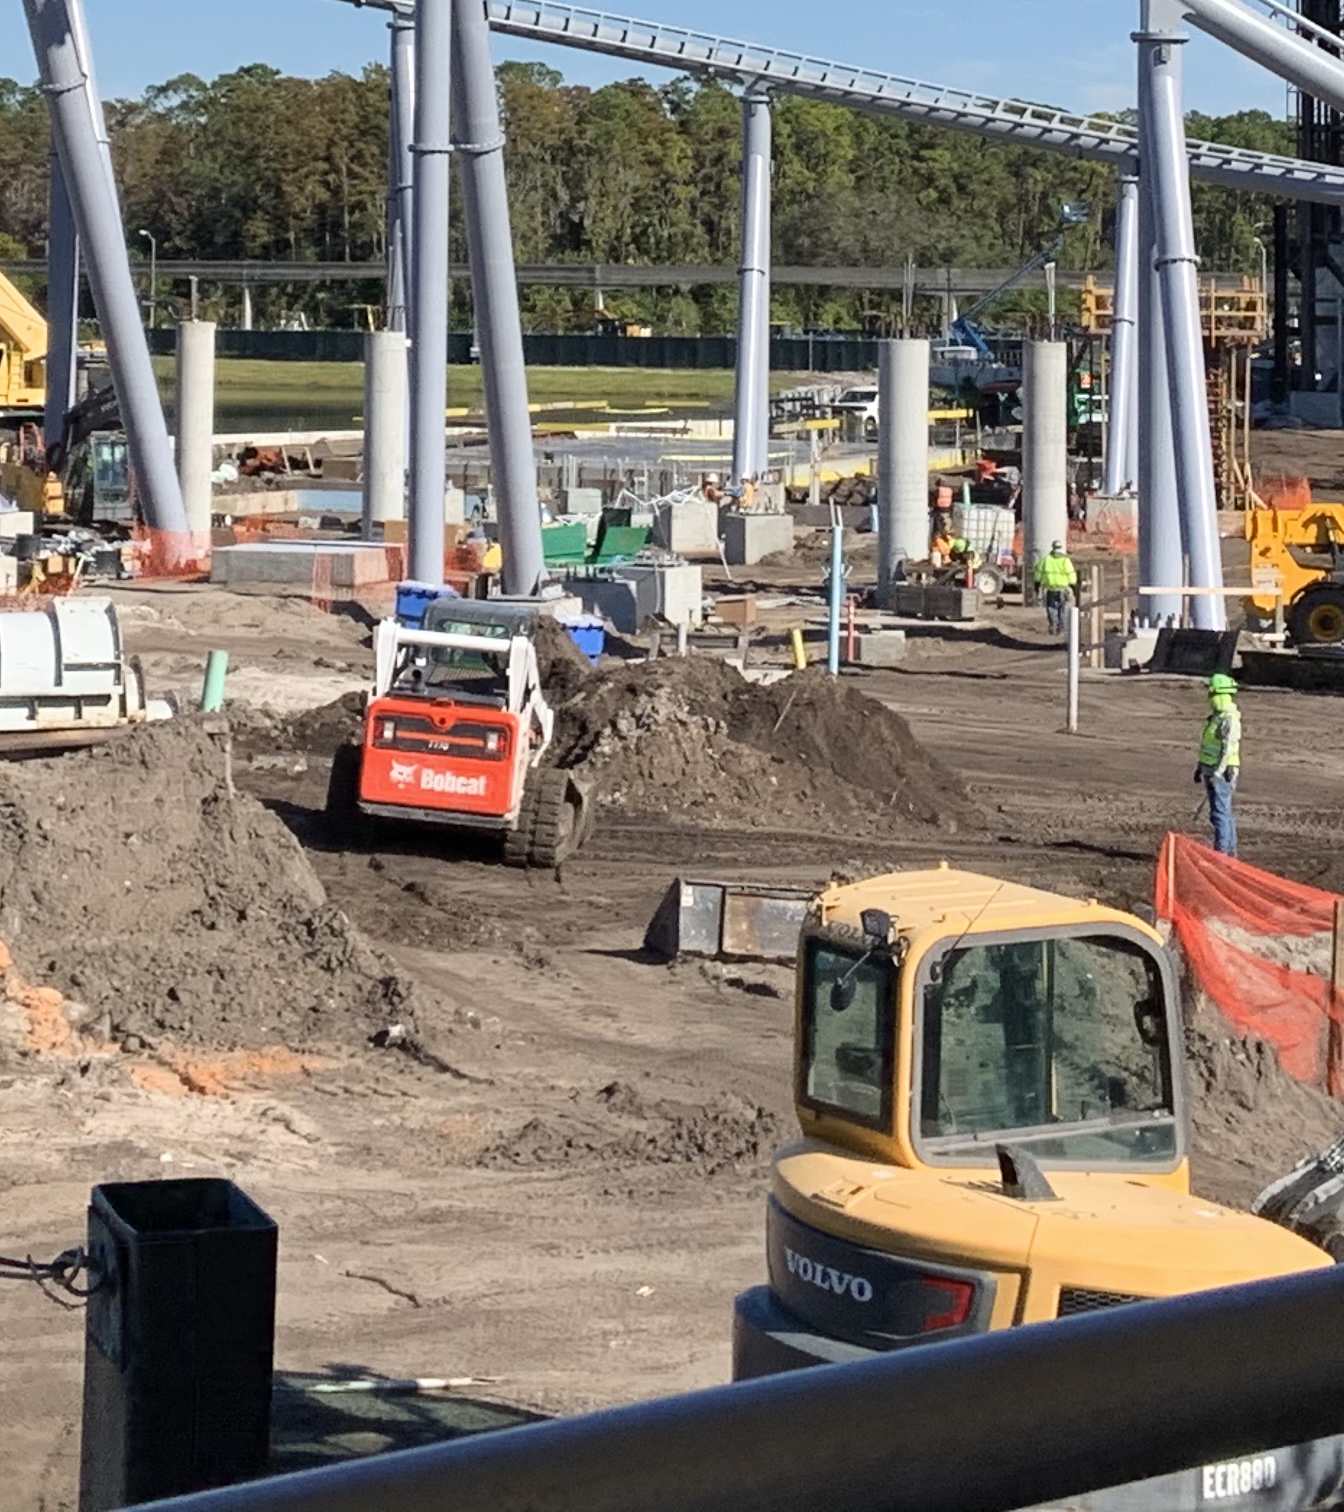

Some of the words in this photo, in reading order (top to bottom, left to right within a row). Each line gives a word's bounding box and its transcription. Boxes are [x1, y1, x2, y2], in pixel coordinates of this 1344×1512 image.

[420, 768, 487, 796] Bobcat
[784, 1245, 873, 1302] VOLVO
[1203, 1456, 1276, 1498] ECR88D
